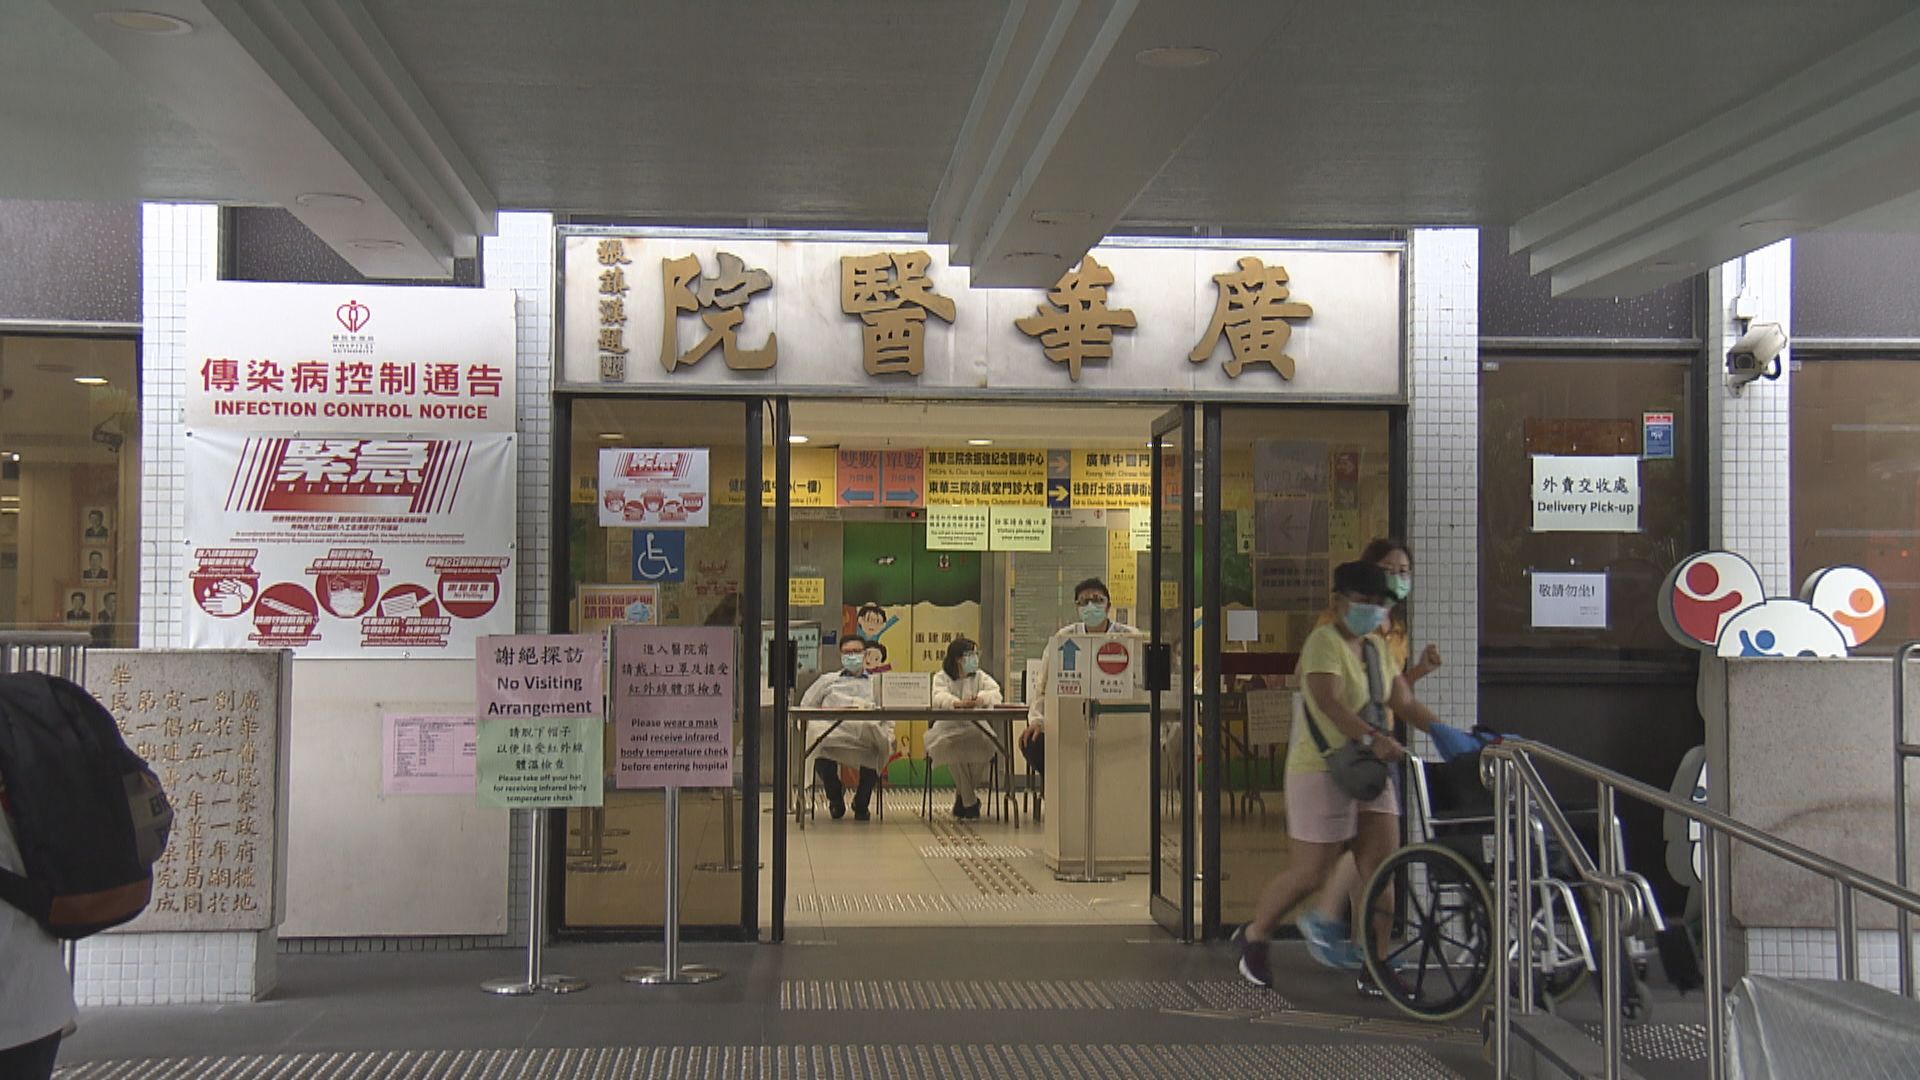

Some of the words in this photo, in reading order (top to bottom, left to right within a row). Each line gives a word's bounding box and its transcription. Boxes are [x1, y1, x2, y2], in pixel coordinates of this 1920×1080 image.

[200, 358, 503, 397] 傳染病控制通告
[214, 401, 316, 418] INFECTION
[324, 402, 413, 419] CONTROL
[420, 403, 488, 420] NOTICE
[276, 439, 430, 484] 緊急
[1537, 500, 1587, 515] Delivery
[1590, 501, 1634, 515] Pick-up
[1538, 583, 1595, 598] 敬請勿坐!
[494, 645, 584, 666] 謝絕探訪
[643, 643, 709, 657] 進入醫院前
[621, 662, 729, 676] 請戴上口罩及接受
[497, 677, 519, 690] No
[524, 675, 583, 692] Visiting
[627, 682, 723, 696] 紅外線體溫檢查
[488, 701, 592, 717] Arrangement
[631, 718, 661, 728] Please
[663, 719, 686, 727] wear
[696, 718, 718, 728] mask
[509, 726, 571, 738] 請脫下帽子
[630, 733, 648, 742] and
[650, 733, 682, 742] receive
[684, 732, 719, 742] infrared
[497, 743, 584, 755] 以便接受紅外線
[621, 747, 643, 759] body
[646, 748, 701, 758] temperature
[704, 747, 729, 757] check
[515, 758, 565, 771] 體溫檢查
[621, 761, 651, 771] before
[653, 763, 690, 773] entering
[692, 761, 729, 773] hospital
[498, 774, 521, 782] Please
[523, 774, 538, 782] take
[540, 774, 551, 782] off
[552, 775, 568, 783] your
[570, 773, 582, 782] hat
[493, 784, 503, 792] for
[505, 784, 538, 793] receiving
[539, 784, 568, 792] infrared
[569, 784, 587, 793] body
[507, 794, 552, 803] temperature
[553, 794, 573, 802] check
